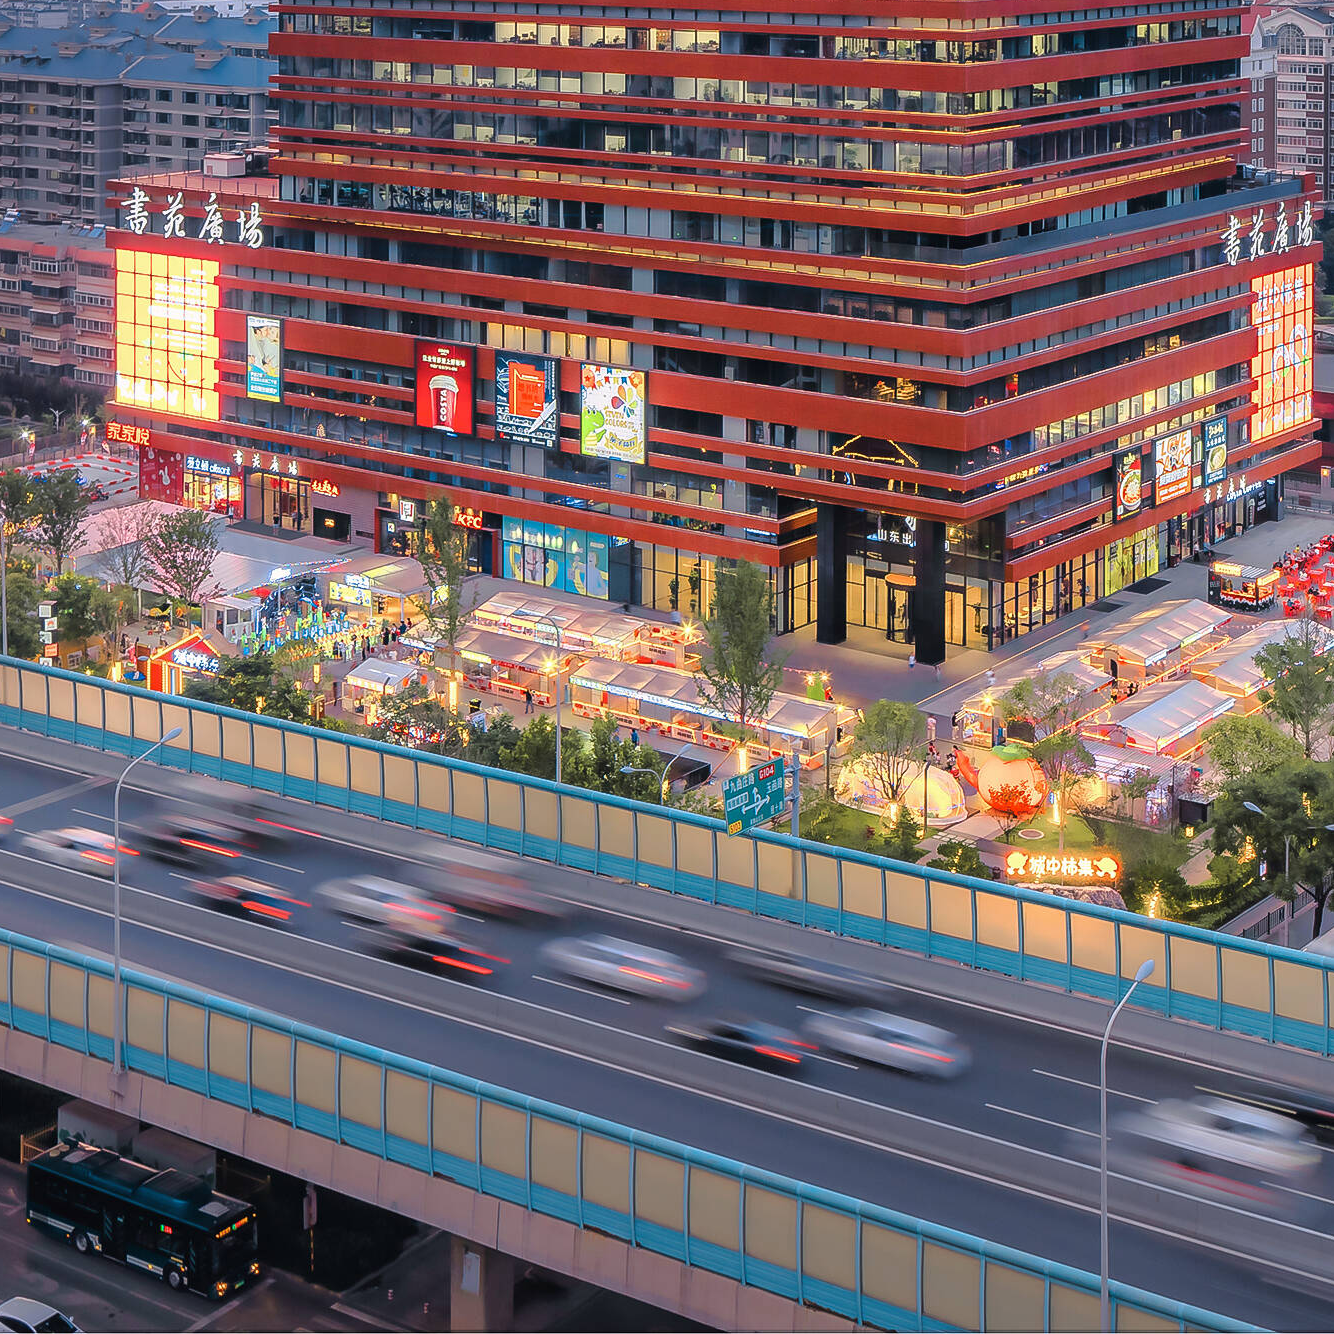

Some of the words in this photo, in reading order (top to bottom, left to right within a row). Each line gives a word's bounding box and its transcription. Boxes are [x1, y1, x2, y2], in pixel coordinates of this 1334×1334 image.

[439, 389, 448, 422] COSTA
[107, 422, 150, 446] 家家悦
[457, 513, 482, 529] KFC
[758, 764, 775, 780] G104
